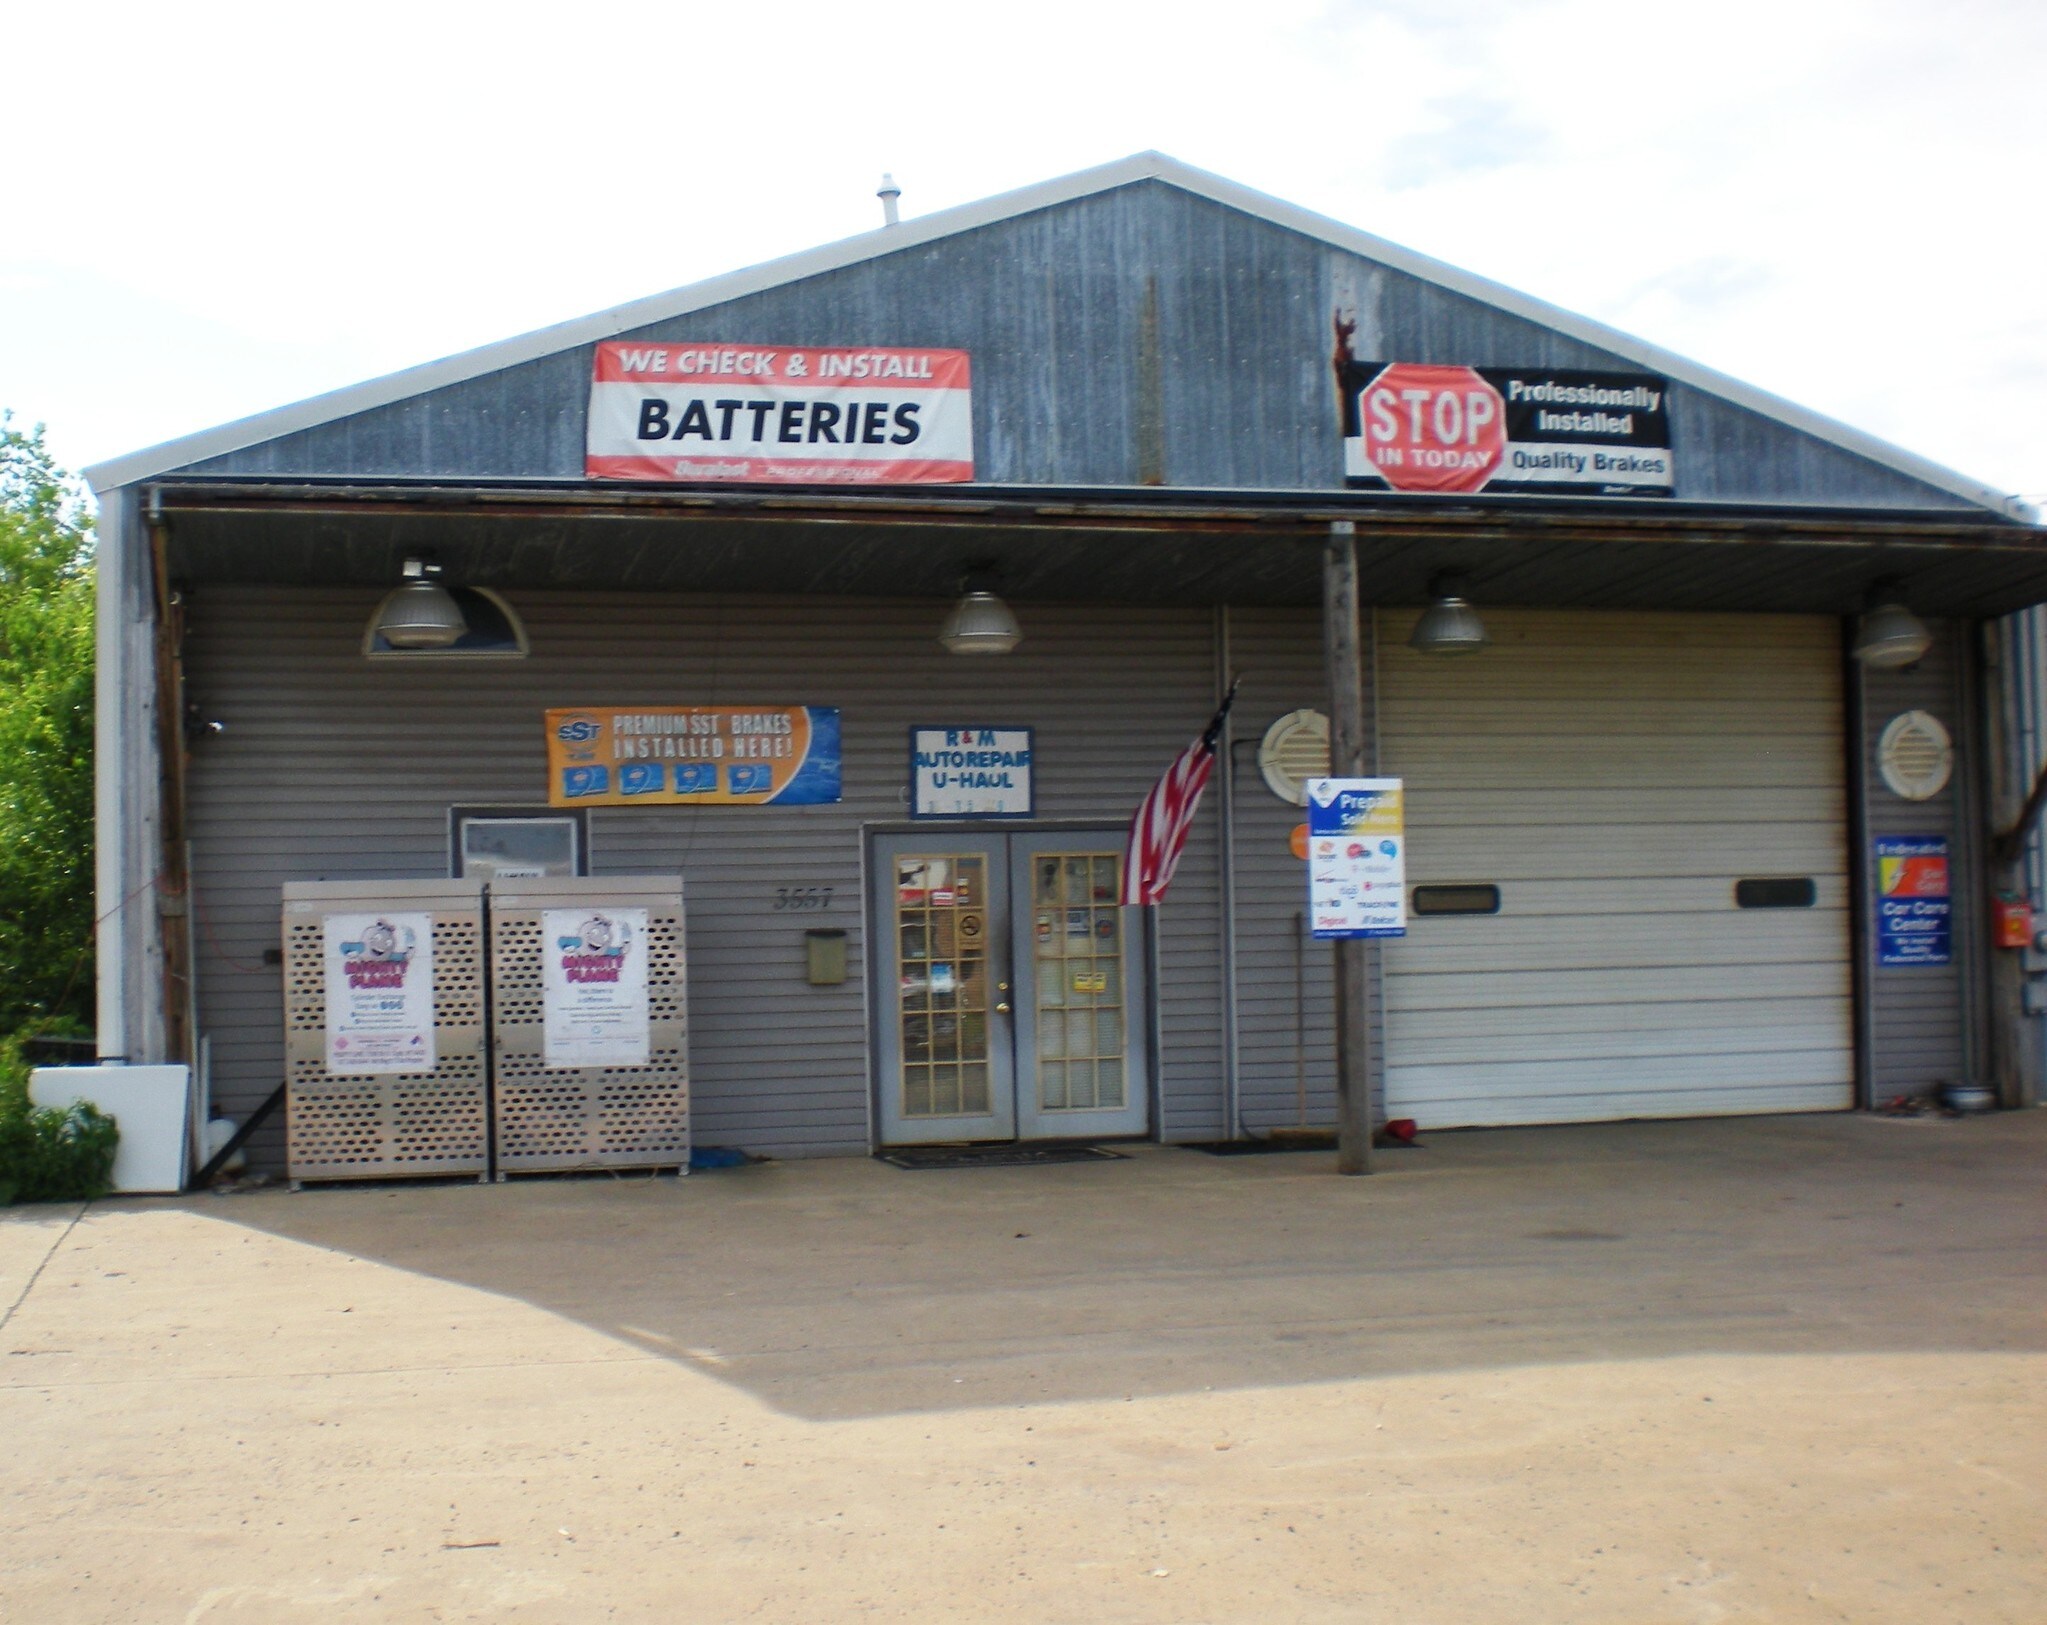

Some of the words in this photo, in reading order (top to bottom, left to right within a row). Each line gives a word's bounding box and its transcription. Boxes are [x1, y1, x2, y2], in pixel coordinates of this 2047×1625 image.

[619, 349, 666, 373] WE
[677, 350, 776, 377] CHECK
[786, 353, 808, 377] &
[818, 353, 934, 379] INSTALL
[1508, 380, 1661, 412] Professionally
[636, 398, 921, 445] BATTERIES
[1371, 388, 1495, 445] STOP
[1538, 409, 1634, 434] Installed
[1376, 447, 1403, 466] IN
[1413, 449, 1492, 469] TODAY
[1512, 450, 1587, 473] Quality
[1594, 453, 1666, 474] Brakes
[557, 721, 602, 742] SST
[613, 714, 688, 735] PREMIUM
[690, 714, 720, 735] SST
[731, 714, 793, 735] BRAKES
[613, 737, 724, 759] INSTALLED
[733, 737, 793, 758] HERE!
[932, 771, 1015, 789] U-HAUL
